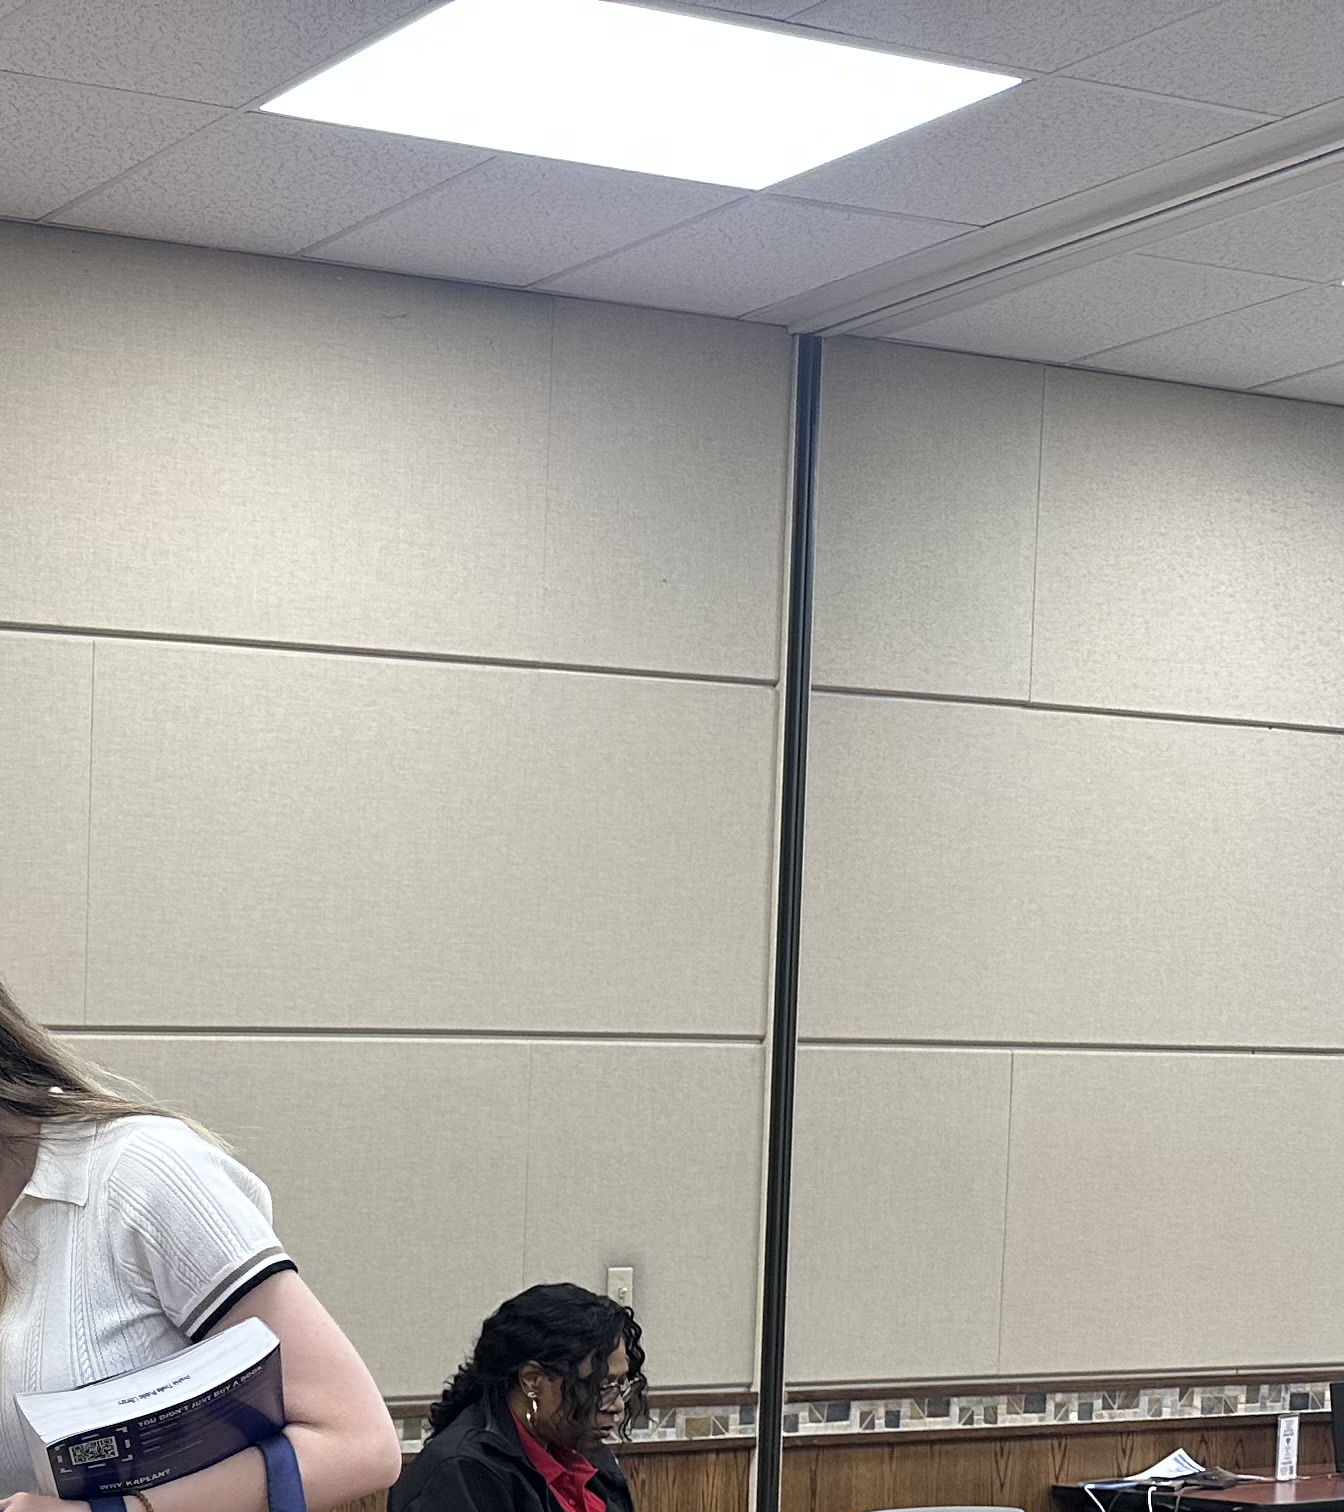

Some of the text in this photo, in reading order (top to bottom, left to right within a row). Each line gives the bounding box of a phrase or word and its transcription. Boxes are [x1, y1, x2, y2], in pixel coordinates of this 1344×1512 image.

[137, 1416, 157, 1428] YOU
[191, 1395, 212, 1409] JUST
[213, 1383, 231, 1398] BUY
[231, 1380, 240, 1389] A
[240, 1365, 263, 1384] BOOK
[99, 1468, 171, 1491] WHY KAPLAN?
